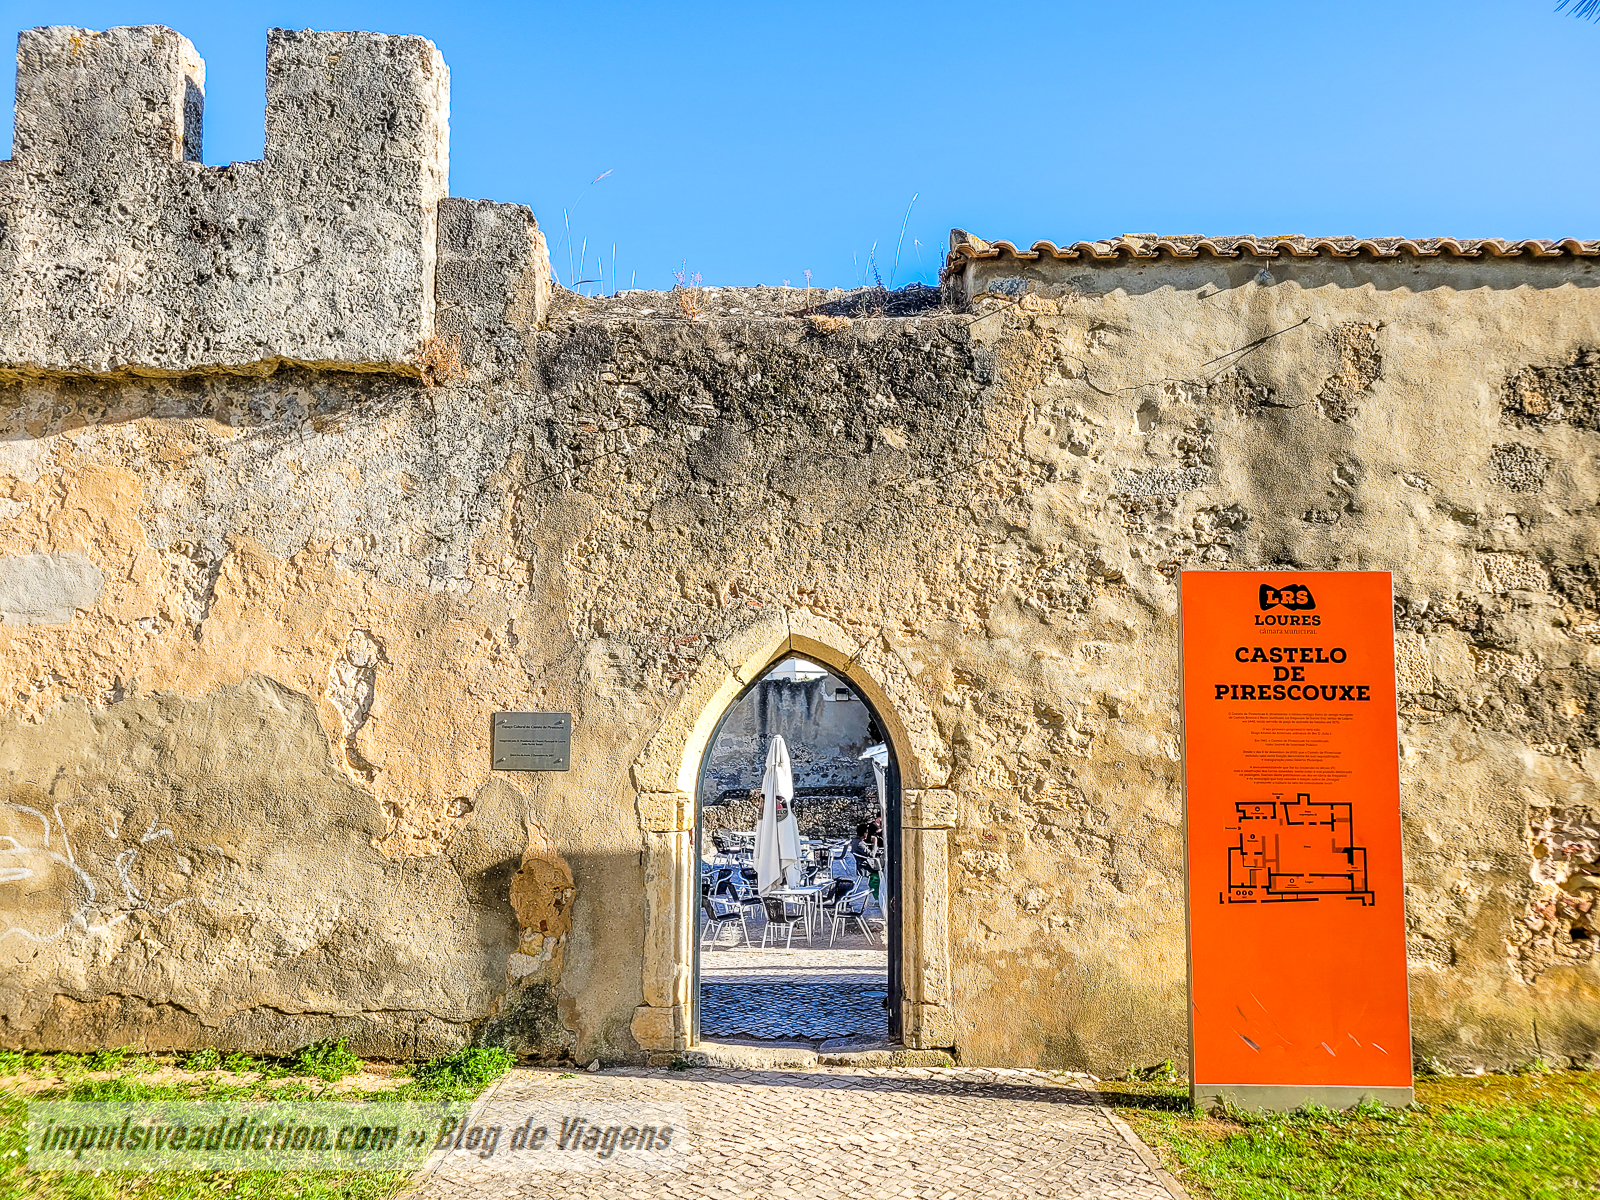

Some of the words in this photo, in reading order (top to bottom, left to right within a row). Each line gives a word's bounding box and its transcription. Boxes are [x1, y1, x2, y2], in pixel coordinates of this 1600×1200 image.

[1266, 590, 1309, 605] LRS
[1254, 614, 1321, 627] LOURES
[1235, 646, 1348, 664] CASTELO
[1273, 665, 1305, 682] DE
[1214, 684, 1371, 701] PIRESCOUXE
